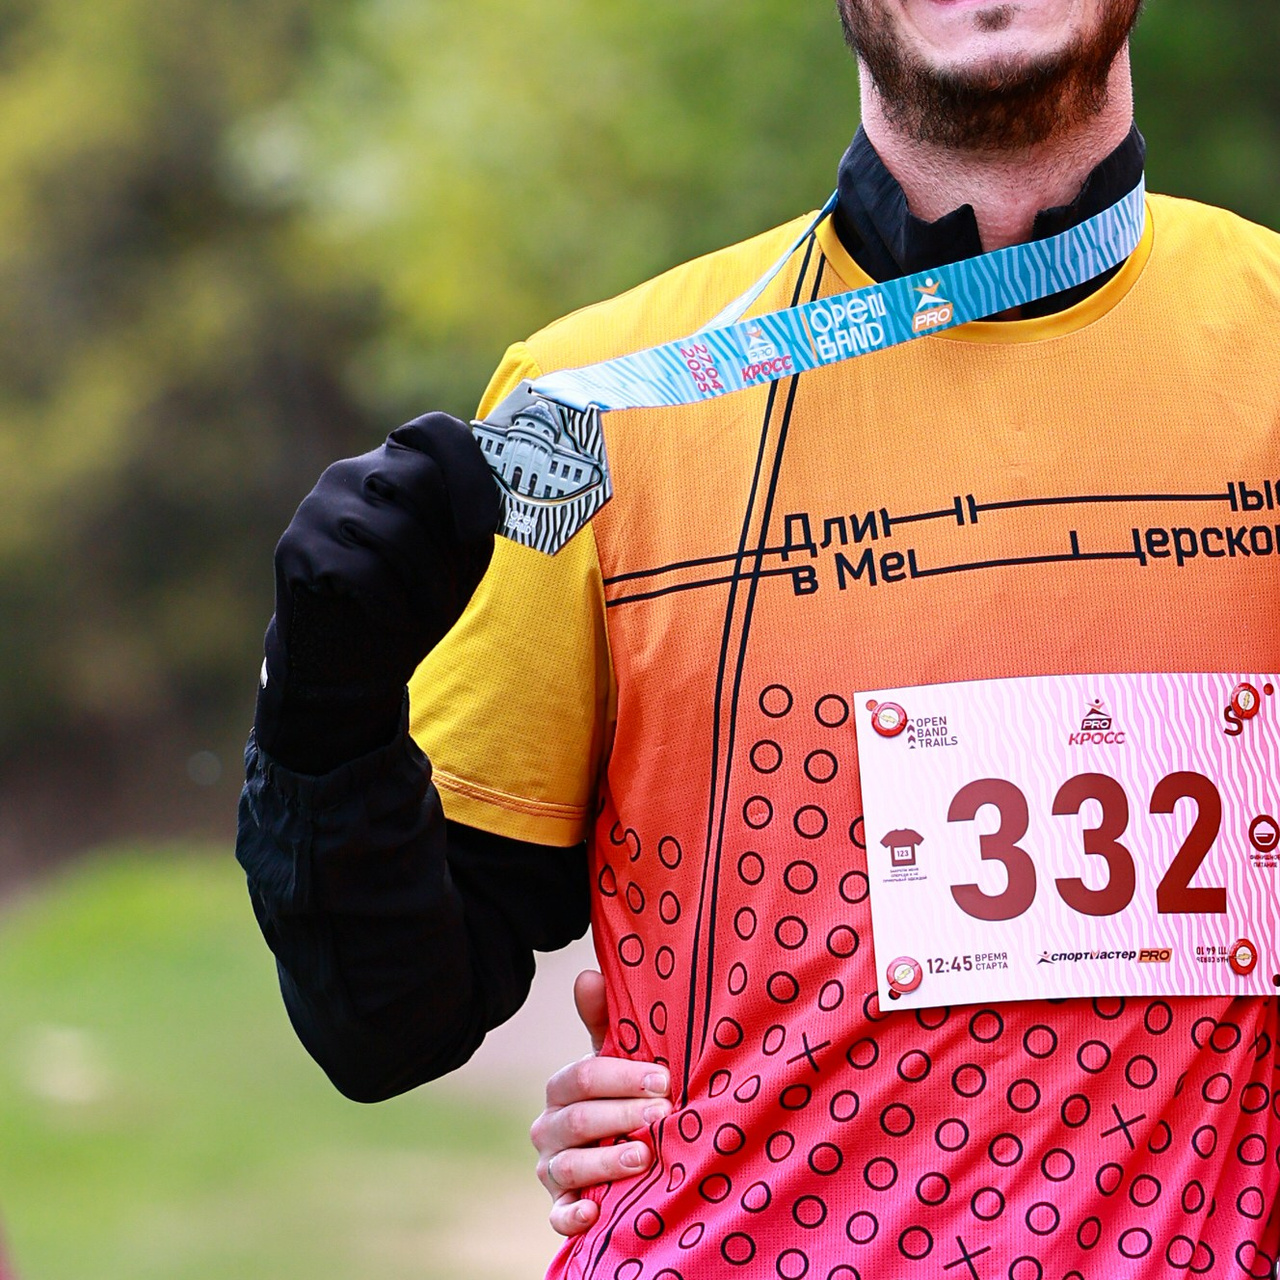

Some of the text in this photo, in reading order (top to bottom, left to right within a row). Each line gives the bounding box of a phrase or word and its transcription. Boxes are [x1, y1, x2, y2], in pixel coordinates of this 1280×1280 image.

[915, 308, 951, 330] PRO
[817, 322, 884, 360] BAND
[680, 348, 711, 392] 2025
[694, 344, 723, 390] 27.04
[742, 355, 793, 382] КРОСС
[916, 716, 947, 728] OPEN
[1082, 720, 1110, 730] PRO
[1223, 705, 1244, 736] S
[917, 726, 948, 738] BAND
[1068, 732, 1126, 746] КРОСС
[918, 736, 958, 748] TRAILS
[947, 771, 1227, 922] 332
[896, 850, 909, 858] 123
[975, 952, 1008, 962] ВРЕМЯ
[1139, 950, 1170, 960] PRO
[927, 955, 973, 974] 12:45
[975, 961, 1008, 971] СТАРТА
